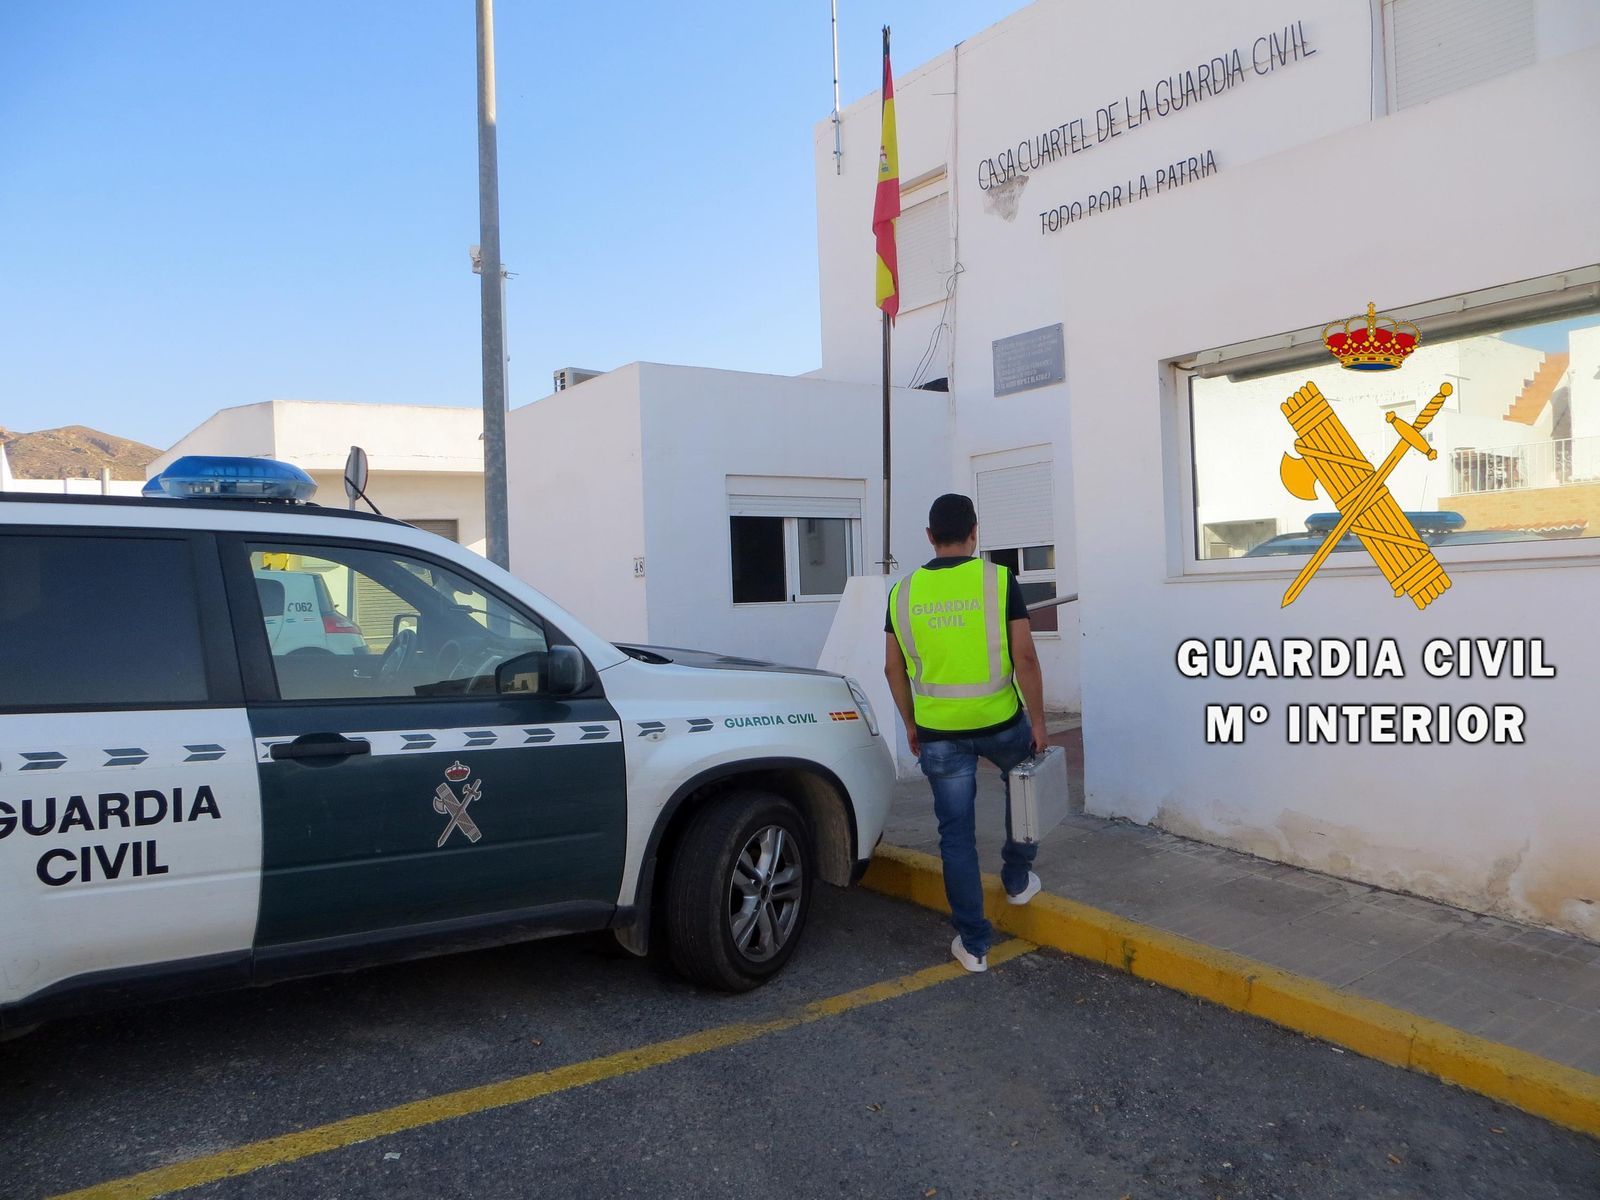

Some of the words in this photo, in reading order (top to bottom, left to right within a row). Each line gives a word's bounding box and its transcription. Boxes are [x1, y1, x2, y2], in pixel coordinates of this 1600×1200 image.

[977, 148, 1016, 191] CASA
[1017, 117, 1092, 172] CUARTEL
[1096, 101, 1122, 143] DE
[1125, 89, 1151, 129] LA
[1155, 48, 1245, 117] GUARDIA
[1252, 20, 1316, 76] CIVIL
[1156, 149, 1218, 194] PATRIA
[295, 602, 313, 612] 062
[911, 599, 981, 616] GUARDIA
[927, 615, 966, 630] CIVIL
[724, 715, 785, 729] GUARDIA
[787, 713, 818, 724] CIVIL
[36, 840, 169, 887] CIVIL
